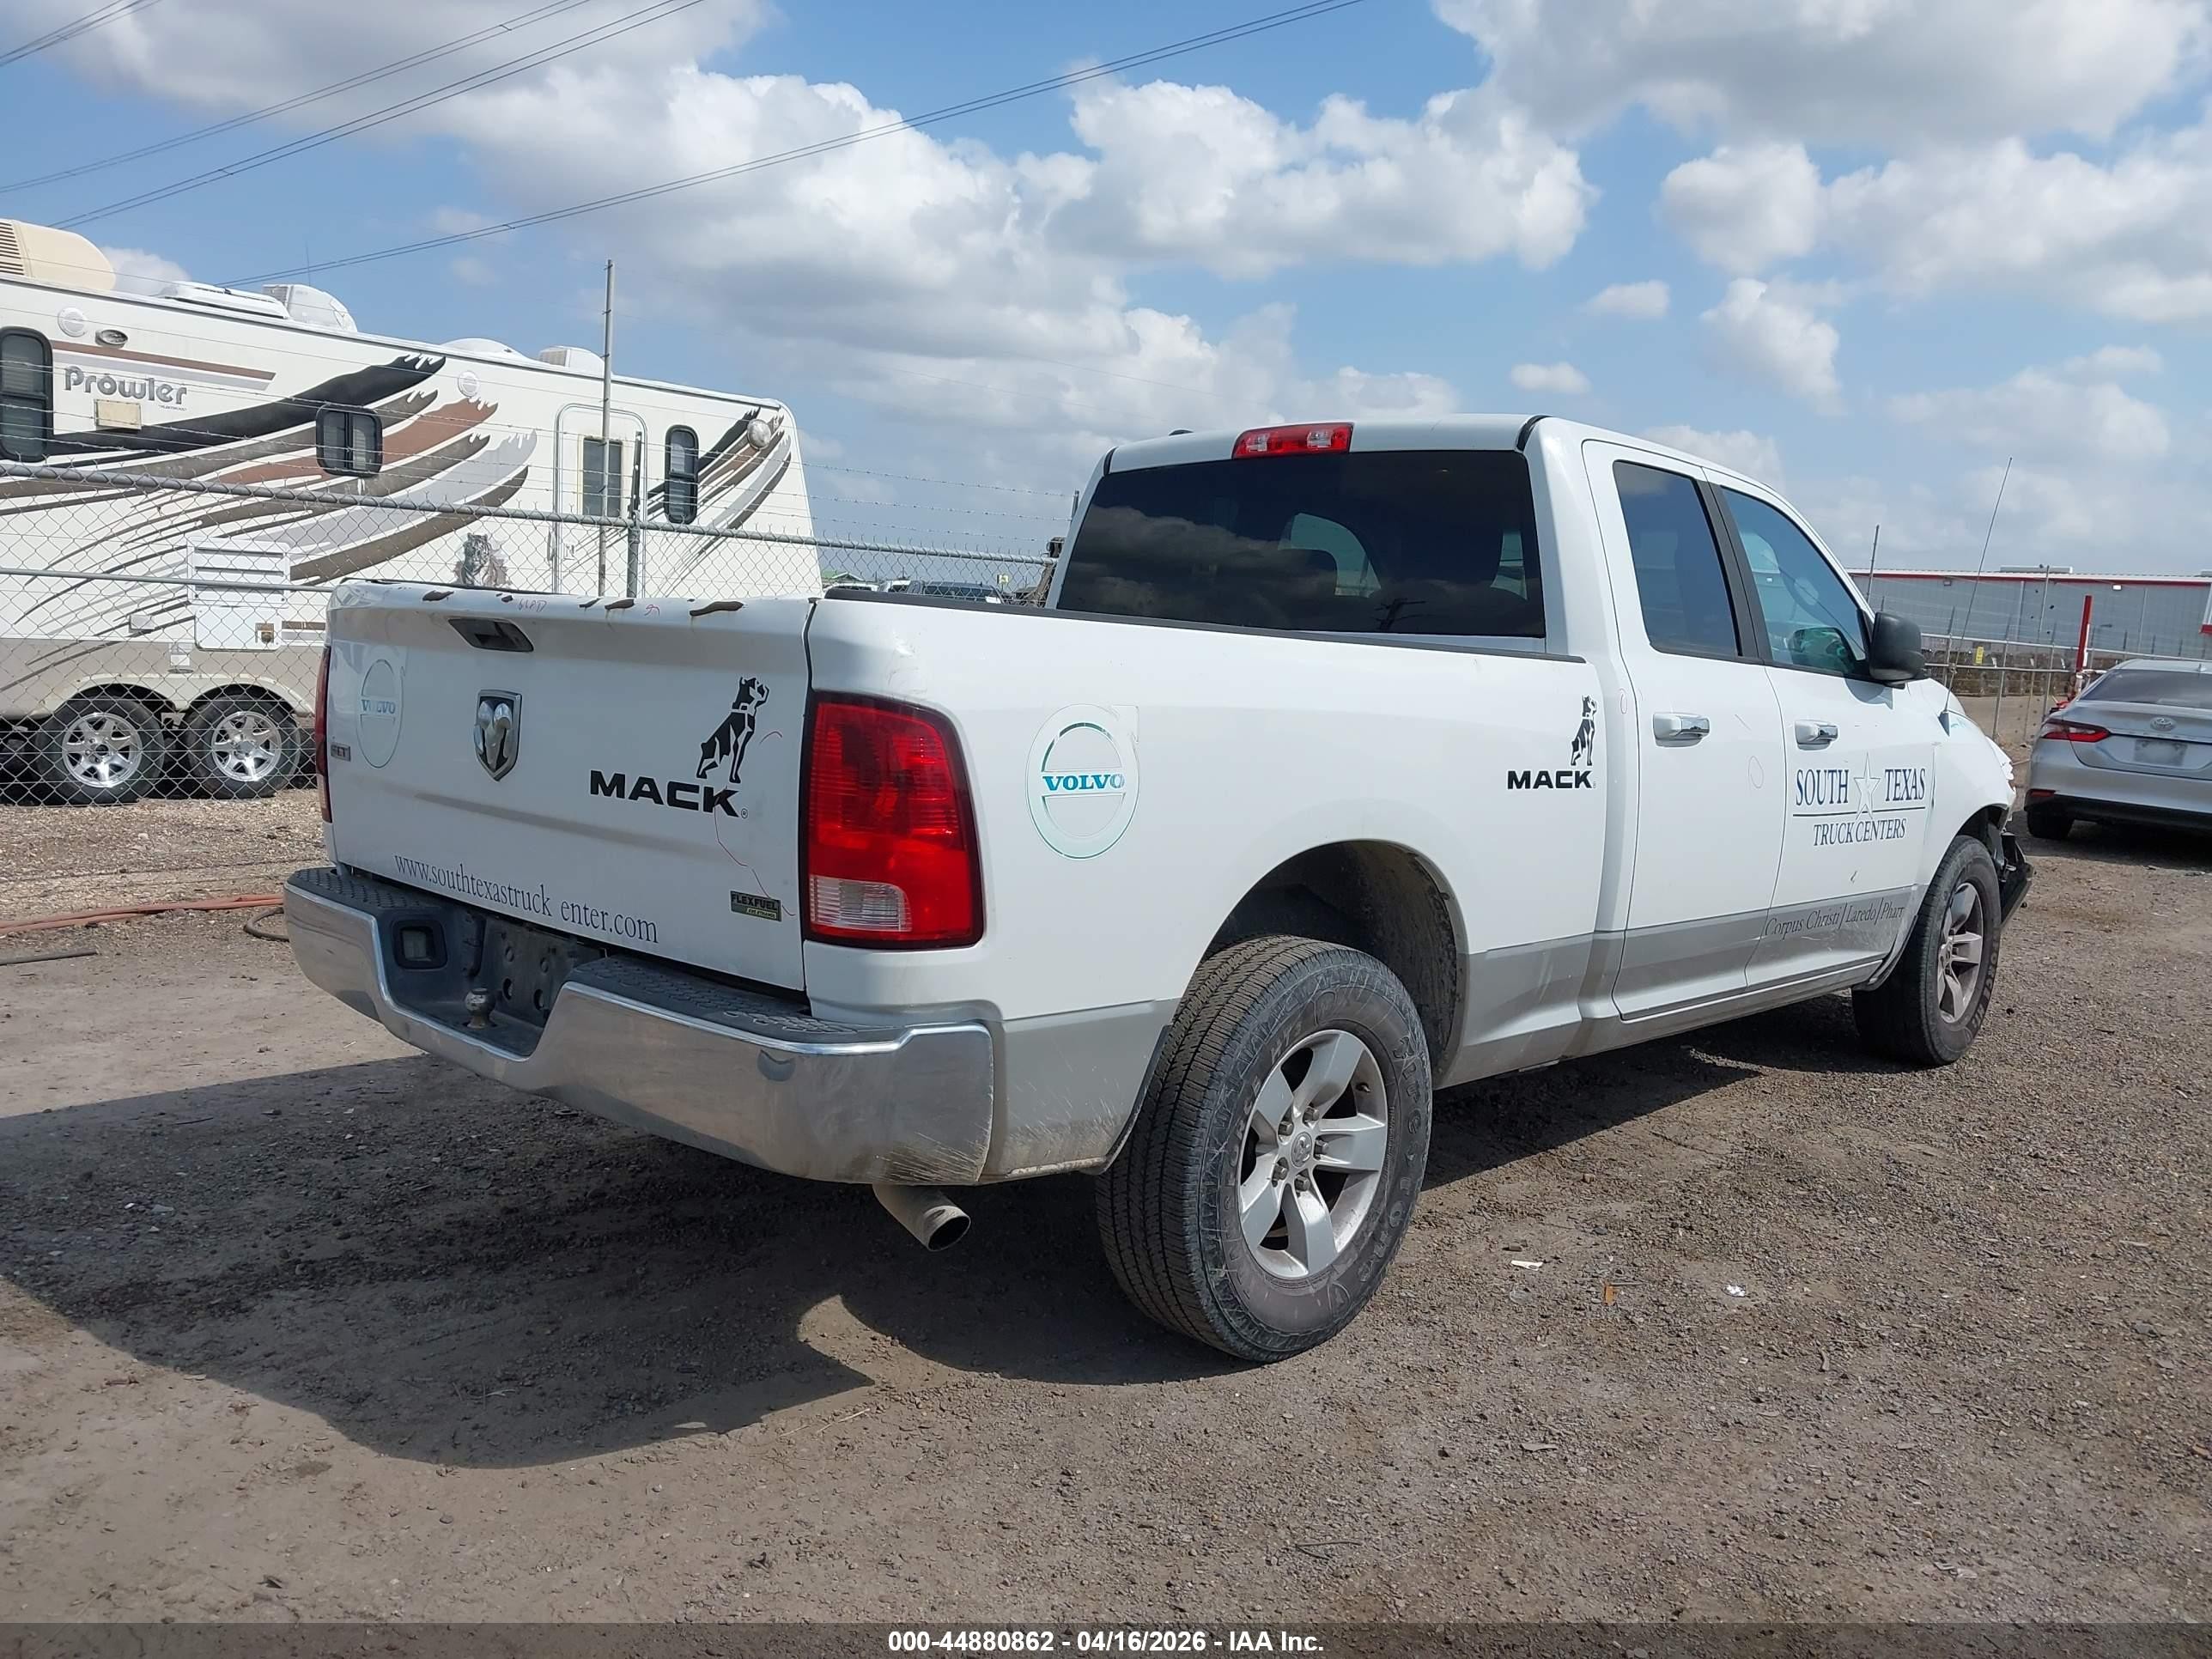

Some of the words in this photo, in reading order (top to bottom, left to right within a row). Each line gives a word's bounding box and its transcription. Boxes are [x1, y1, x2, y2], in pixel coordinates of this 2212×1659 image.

[64, 366, 187, 404] Prowler
[1042, 774, 1125, 791] VOLVO
[1507, 770, 1593, 789] MACK
[1796, 769, 1850, 806] SOUTH
[1884, 768, 1926, 801] TEXAS
[1813, 821, 1855, 846] TRUCK
[1855, 817, 1907, 842] CENTERS
[1765, 917, 1804, 940] Corpus
